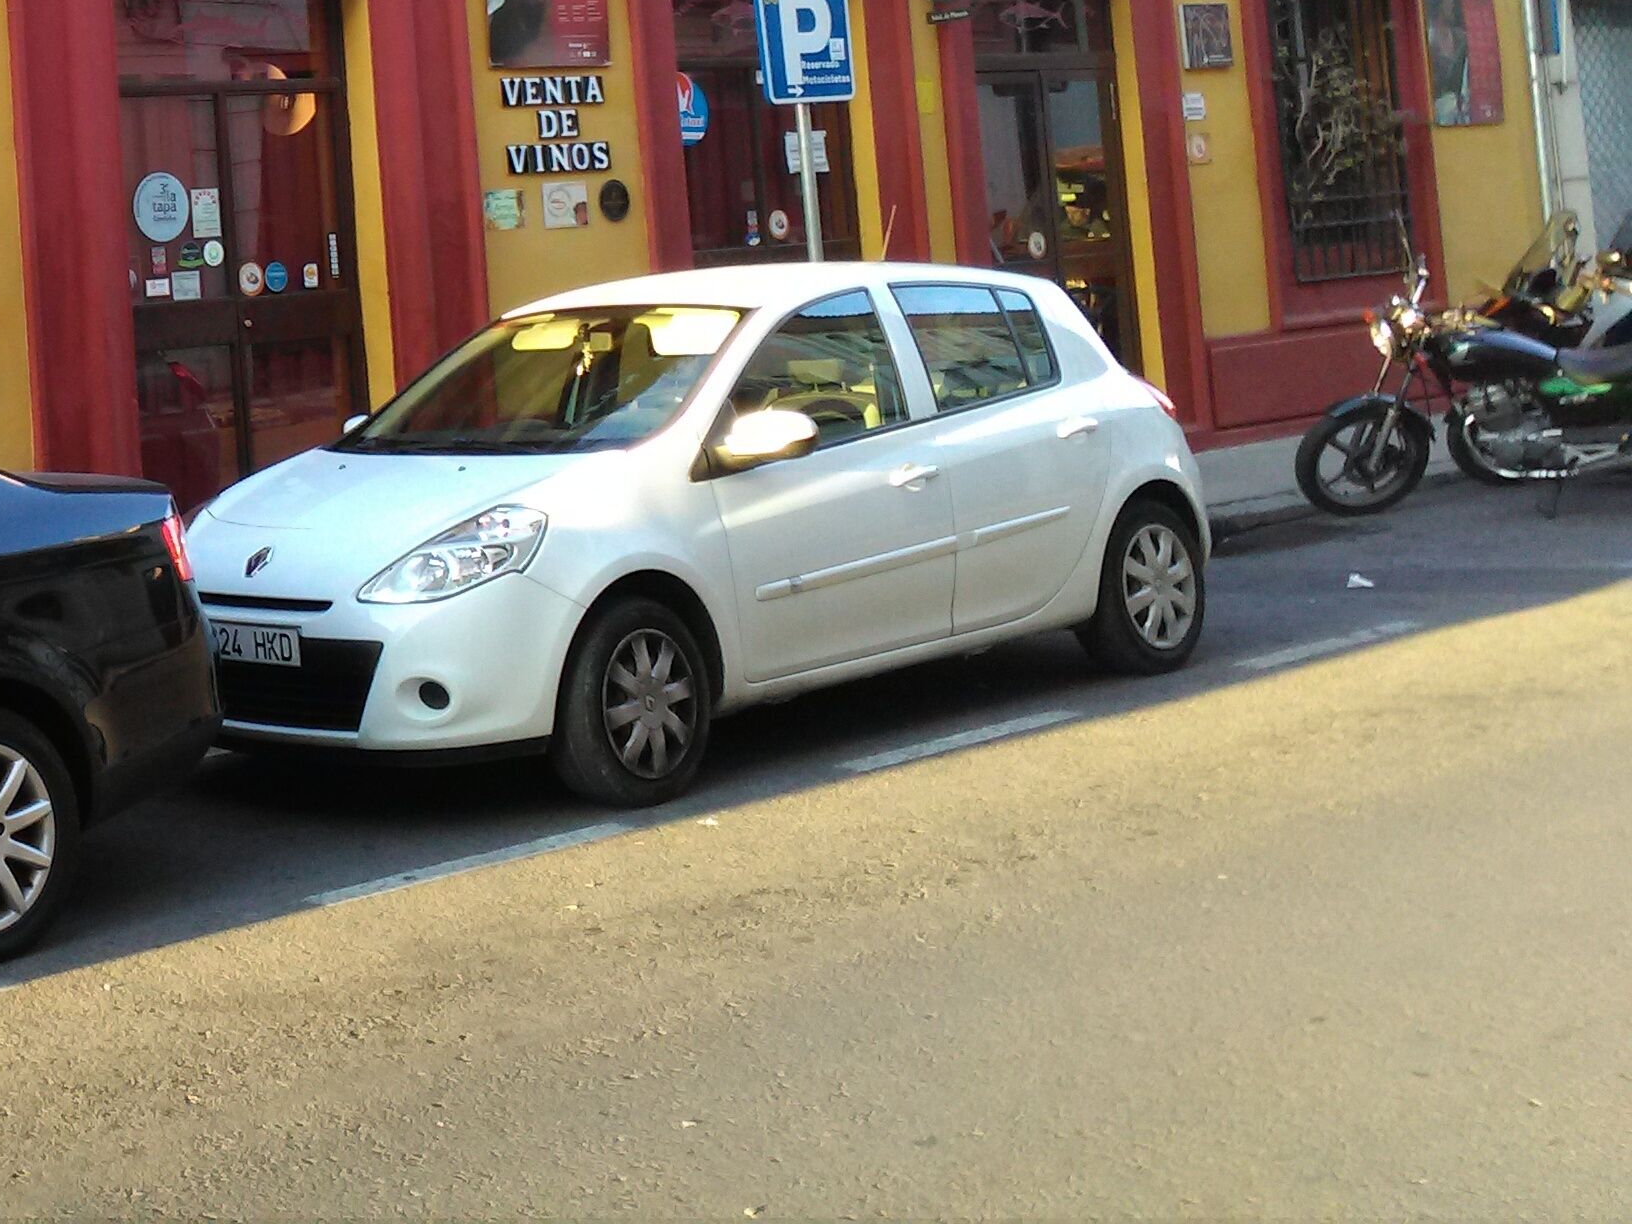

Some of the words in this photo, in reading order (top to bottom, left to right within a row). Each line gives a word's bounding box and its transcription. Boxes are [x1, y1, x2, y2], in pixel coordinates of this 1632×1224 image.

[501, 76, 605, 106] VENTA
[537, 109, 579, 138] DE
[507, 142, 609, 173] VINOS
[152, 202, 177, 215] tapa
[253, 631, 293, 662] HKD
